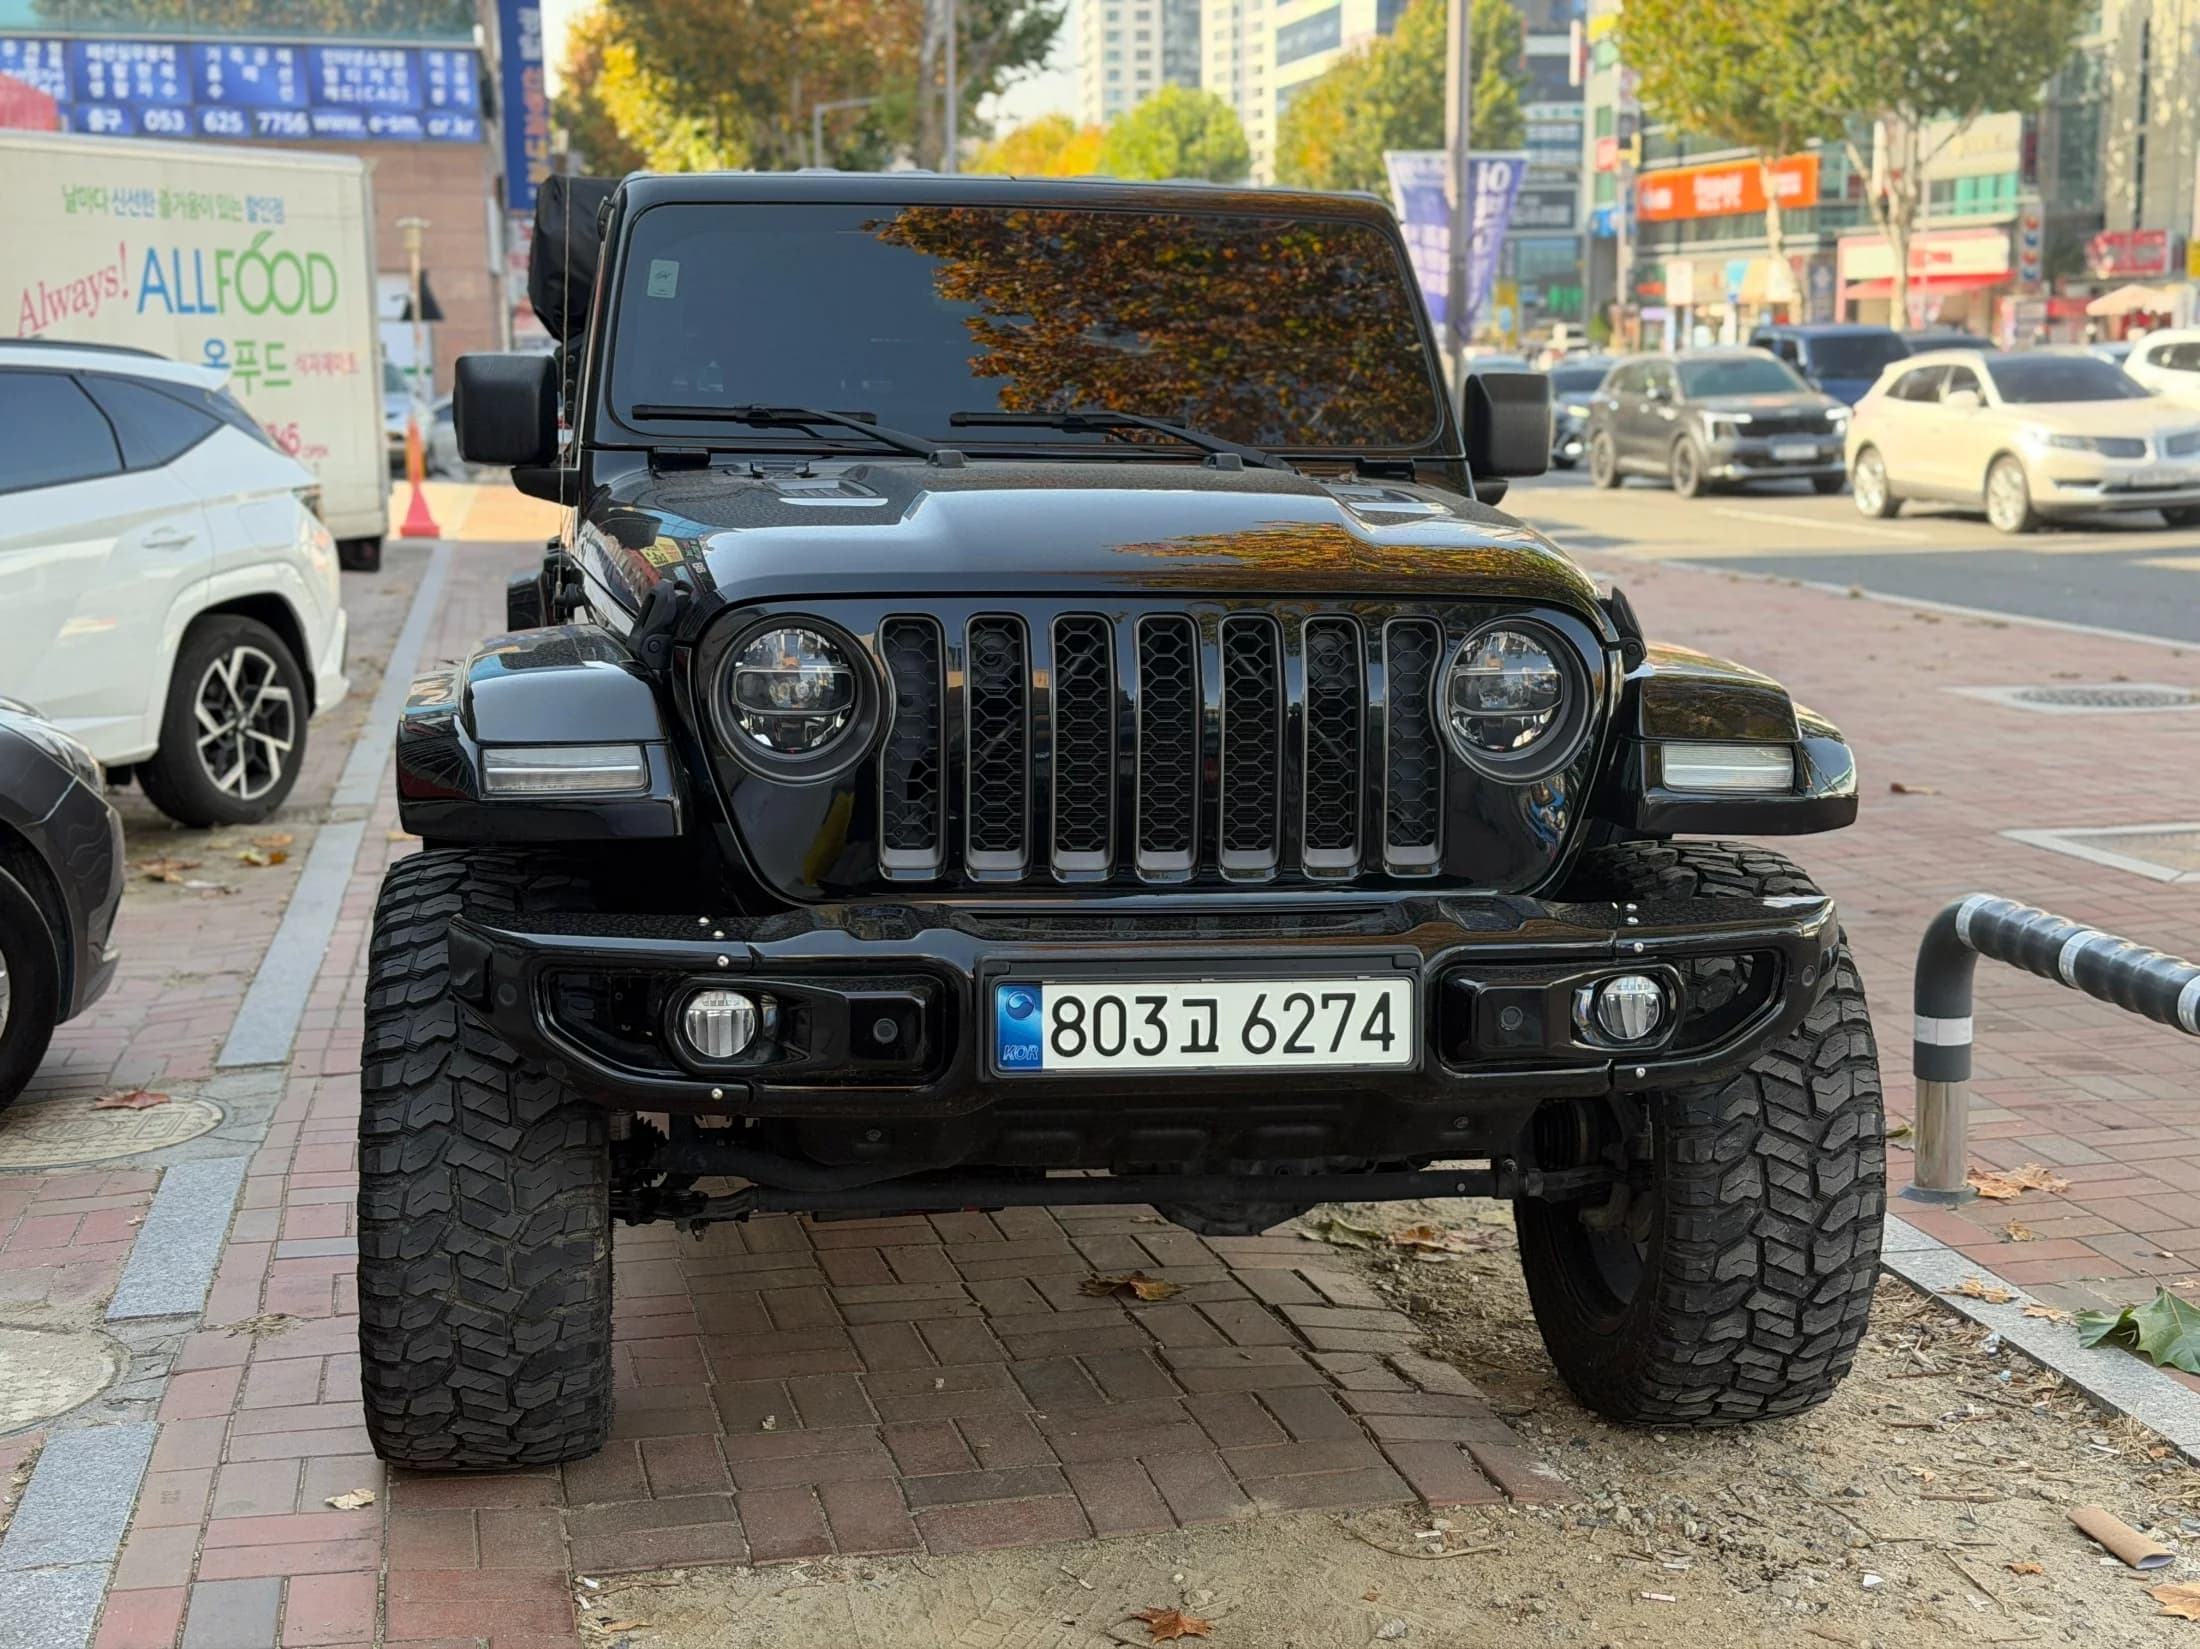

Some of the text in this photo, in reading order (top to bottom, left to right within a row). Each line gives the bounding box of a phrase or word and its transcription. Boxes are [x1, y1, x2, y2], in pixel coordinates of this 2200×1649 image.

[143, 109, 185, 132] 053
[203, 111, 244, 134] 625
[16, 240, 129, 339] Always!
[1050, 991, 1396, 1058] 803고 6274
[1003, 1044, 1038, 1061] KOR
